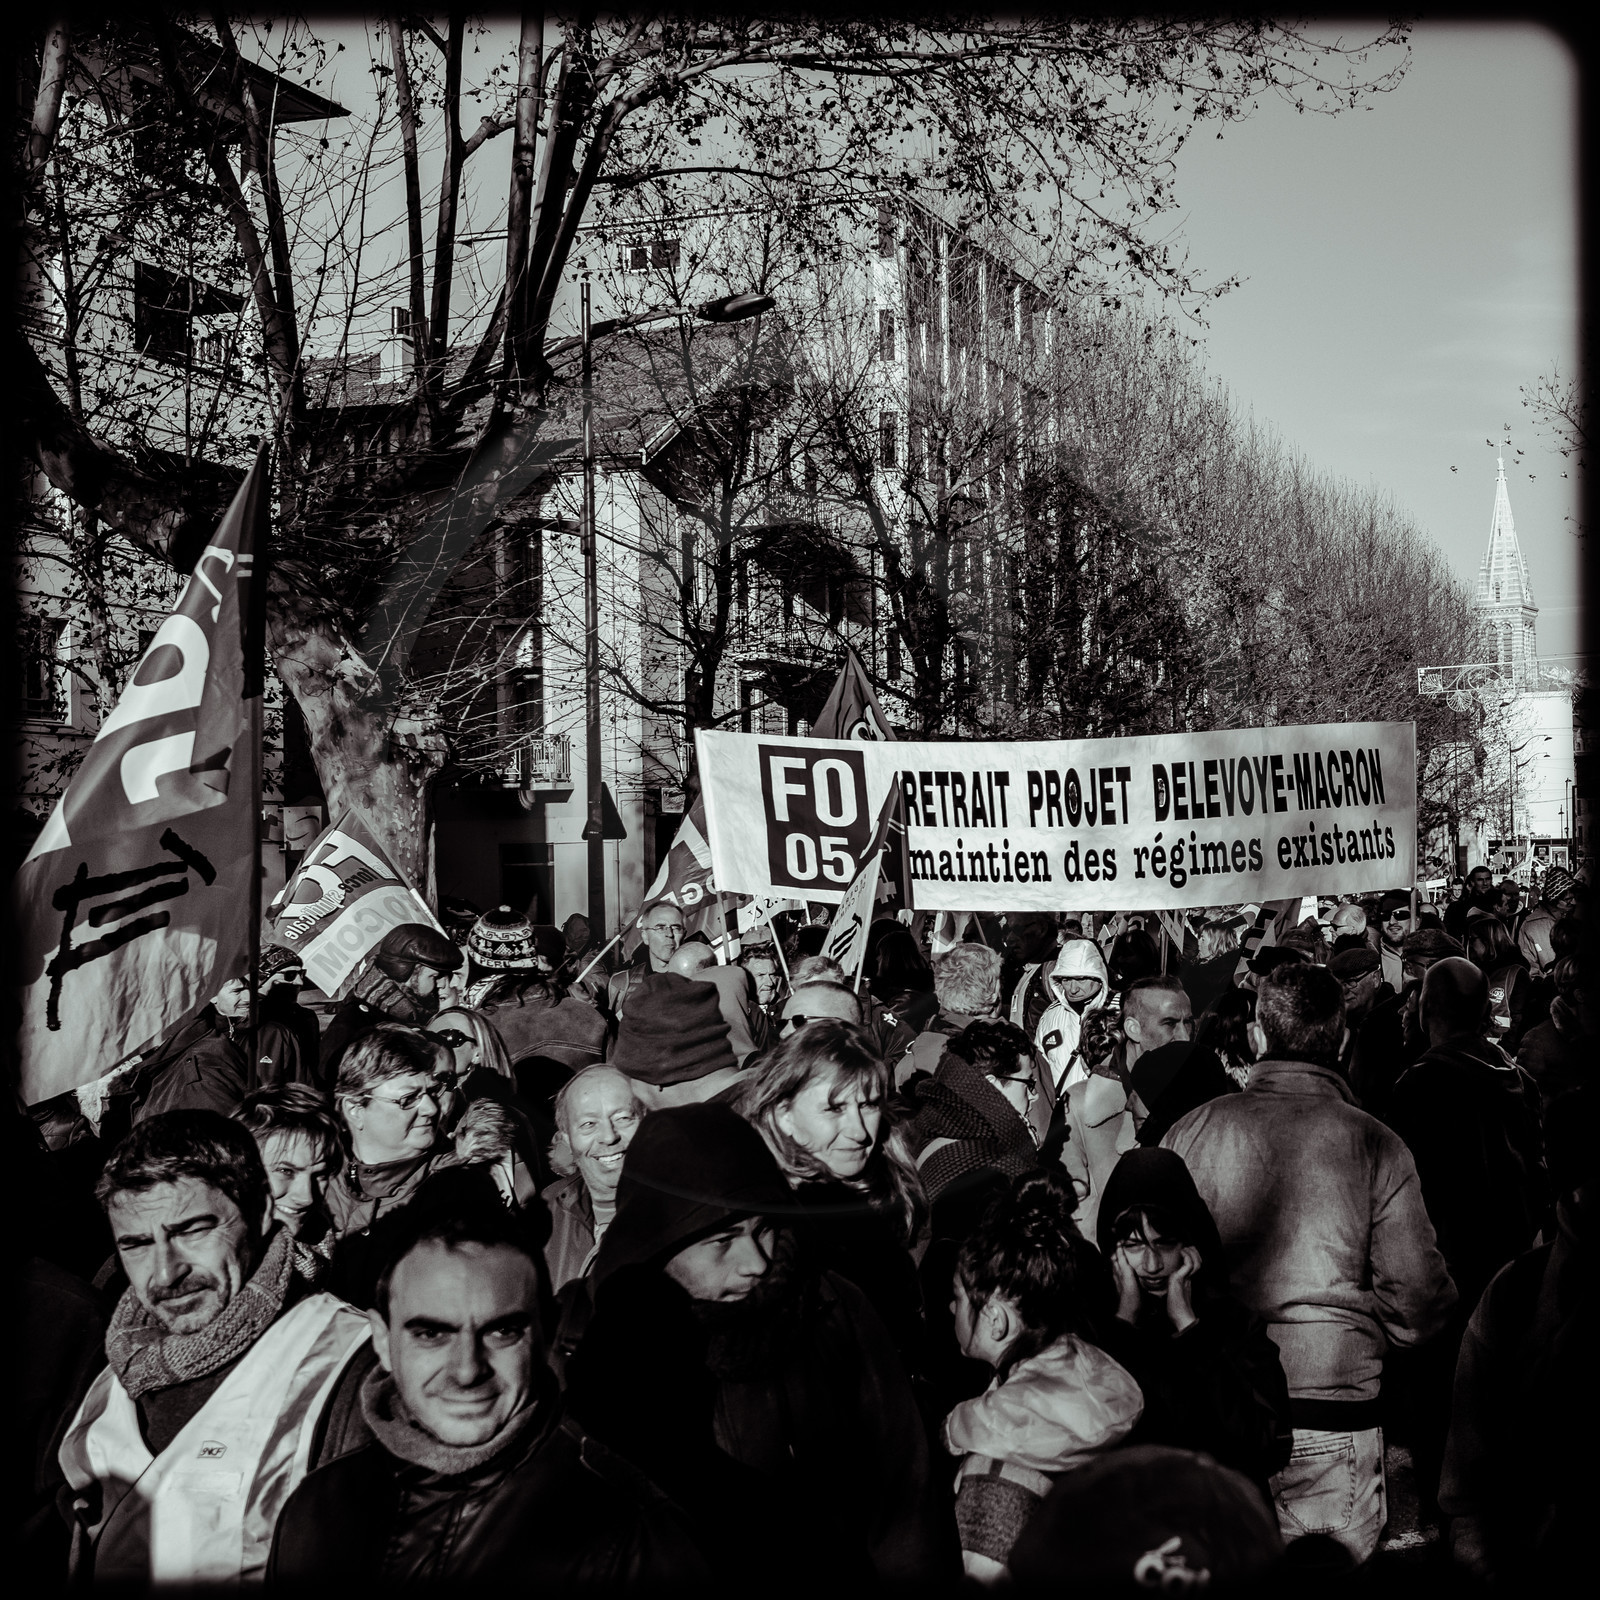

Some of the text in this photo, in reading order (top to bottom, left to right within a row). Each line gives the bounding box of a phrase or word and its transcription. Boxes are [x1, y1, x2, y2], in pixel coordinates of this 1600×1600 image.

[769, 755, 858, 827] FO
[901, 748, 1386, 828] RETRAIT PROJET DELEVOYE-MACRON
[785, 832, 857, 884] 05
[909, 819, 1396, 889] maintien des régimes existants
